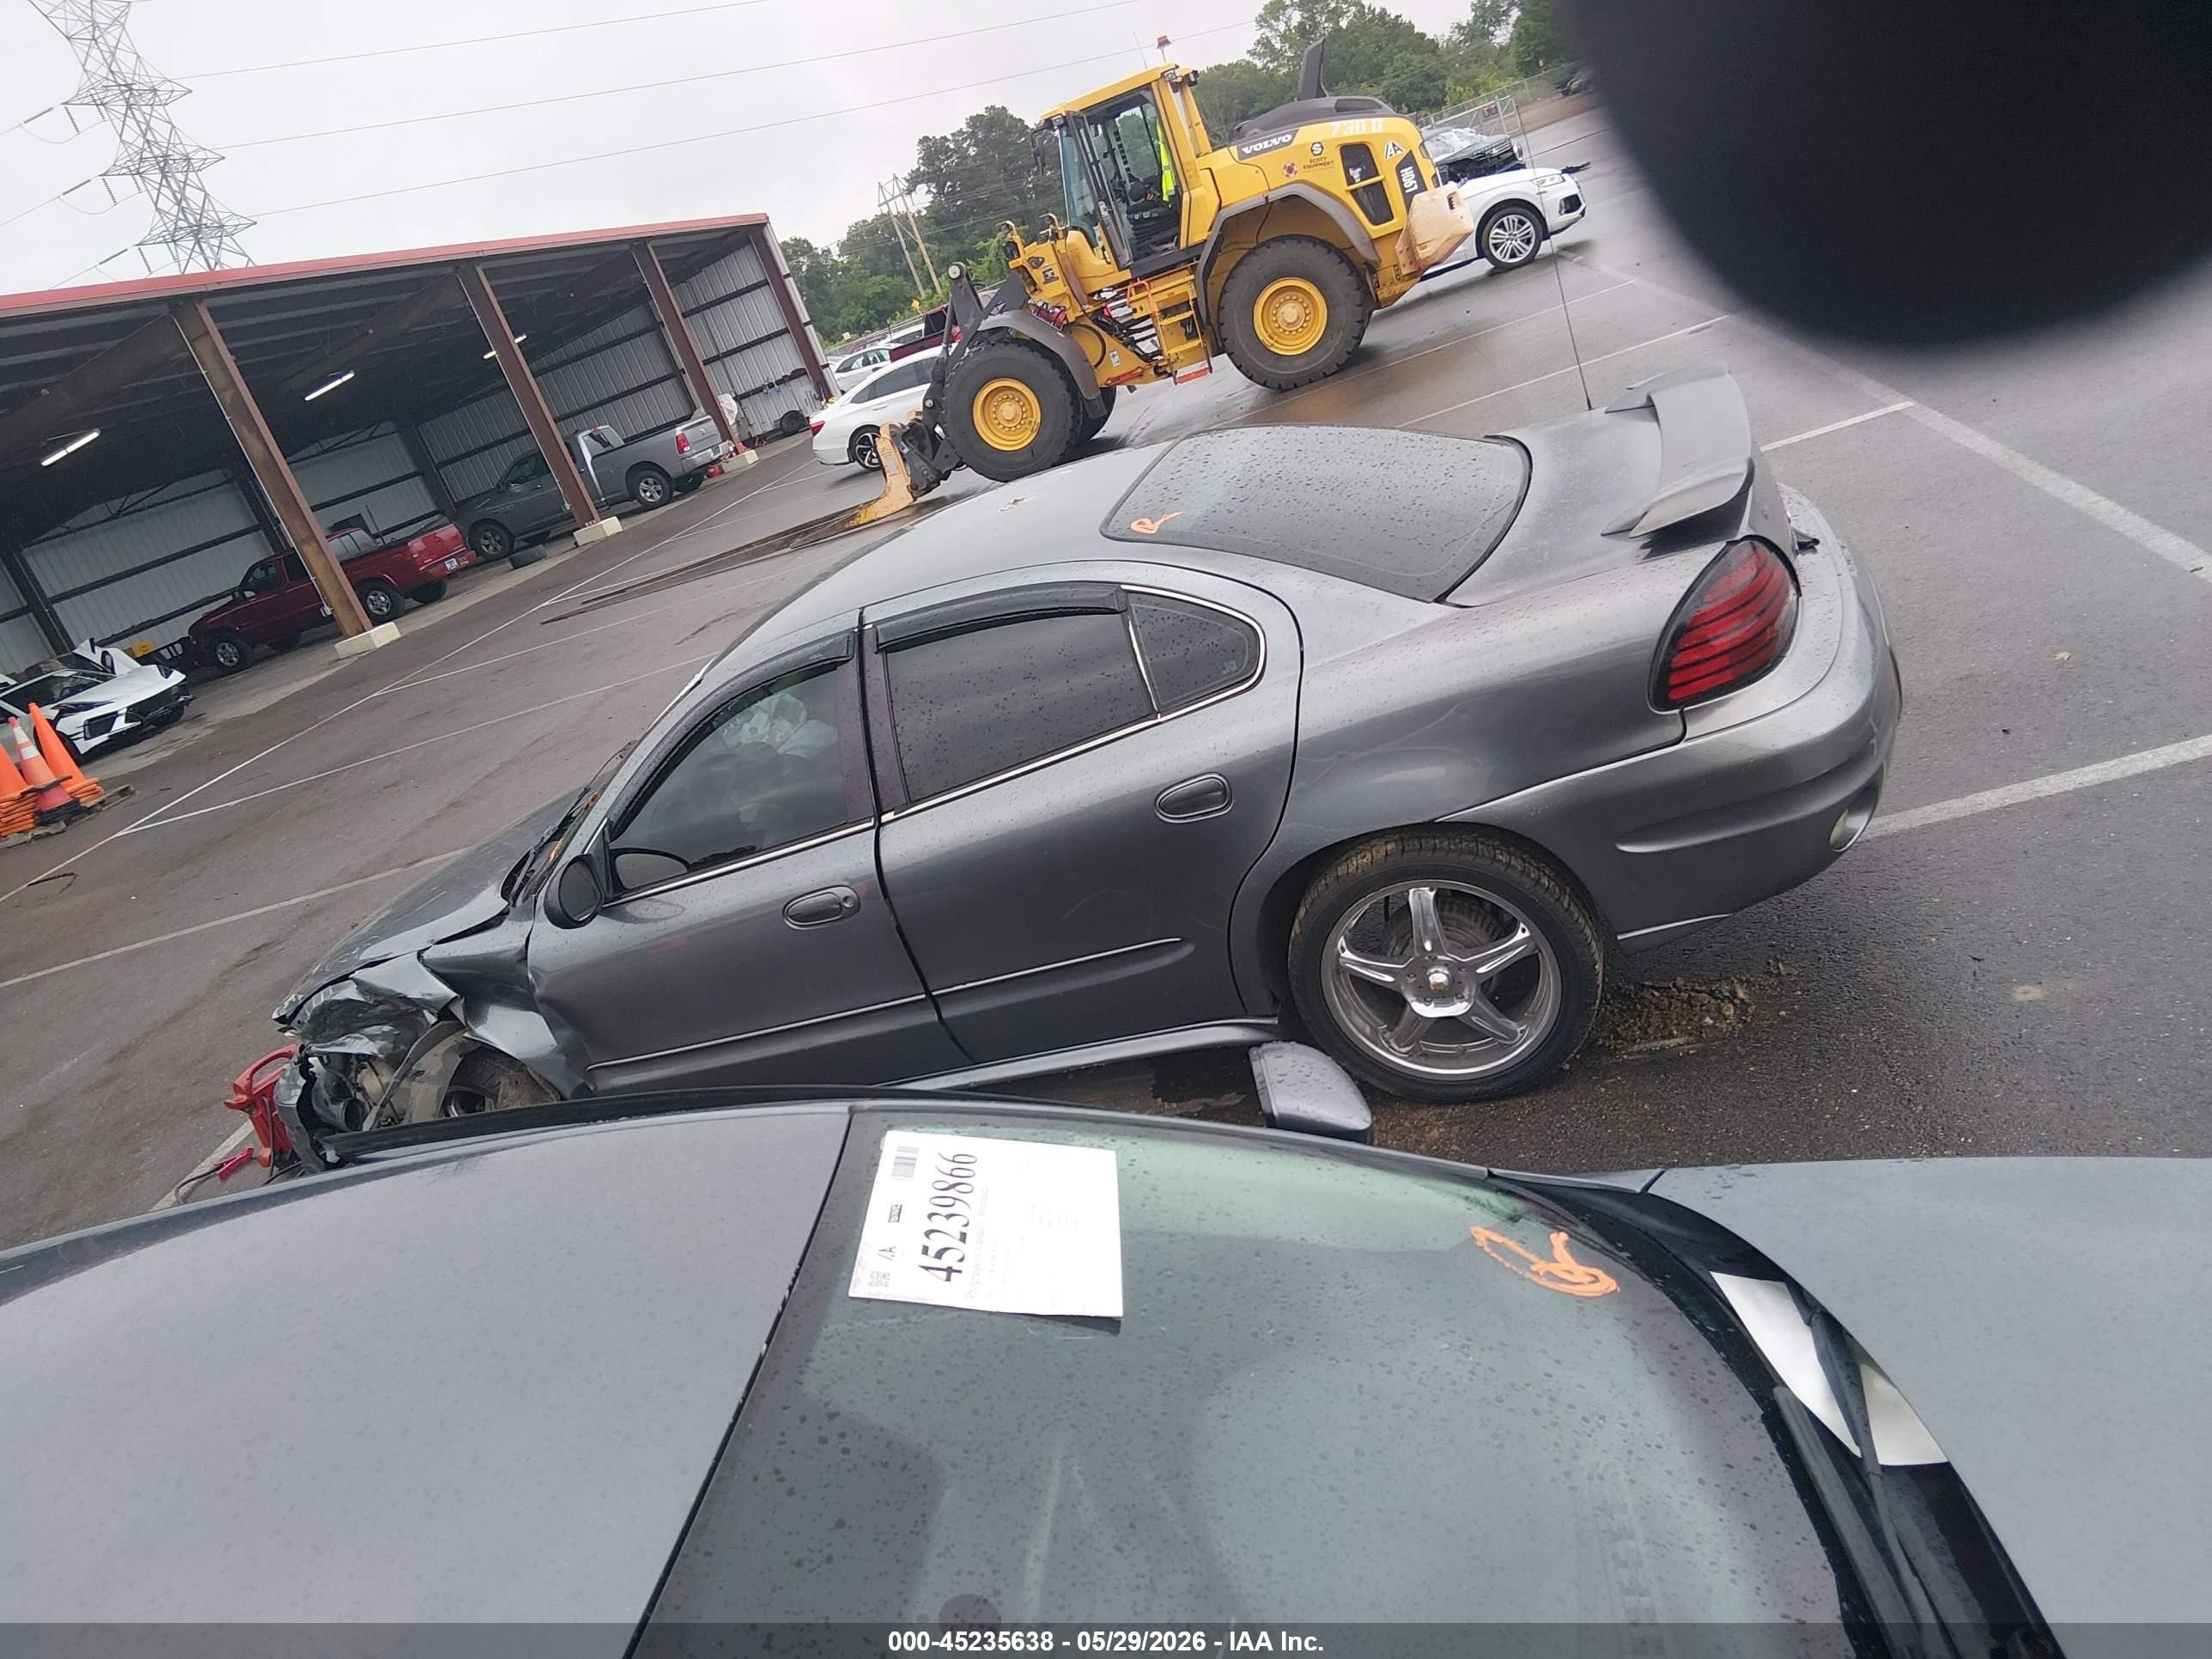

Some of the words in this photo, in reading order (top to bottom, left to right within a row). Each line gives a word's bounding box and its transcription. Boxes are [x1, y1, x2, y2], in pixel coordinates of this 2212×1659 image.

[1241, 134, 1292, 155] VOLVO
[1303, 161, 1334, 170] EQUIPMENT
[1400, 166, 1419, 193] L90H
[918, 1151, 978, 1282] 45239866
